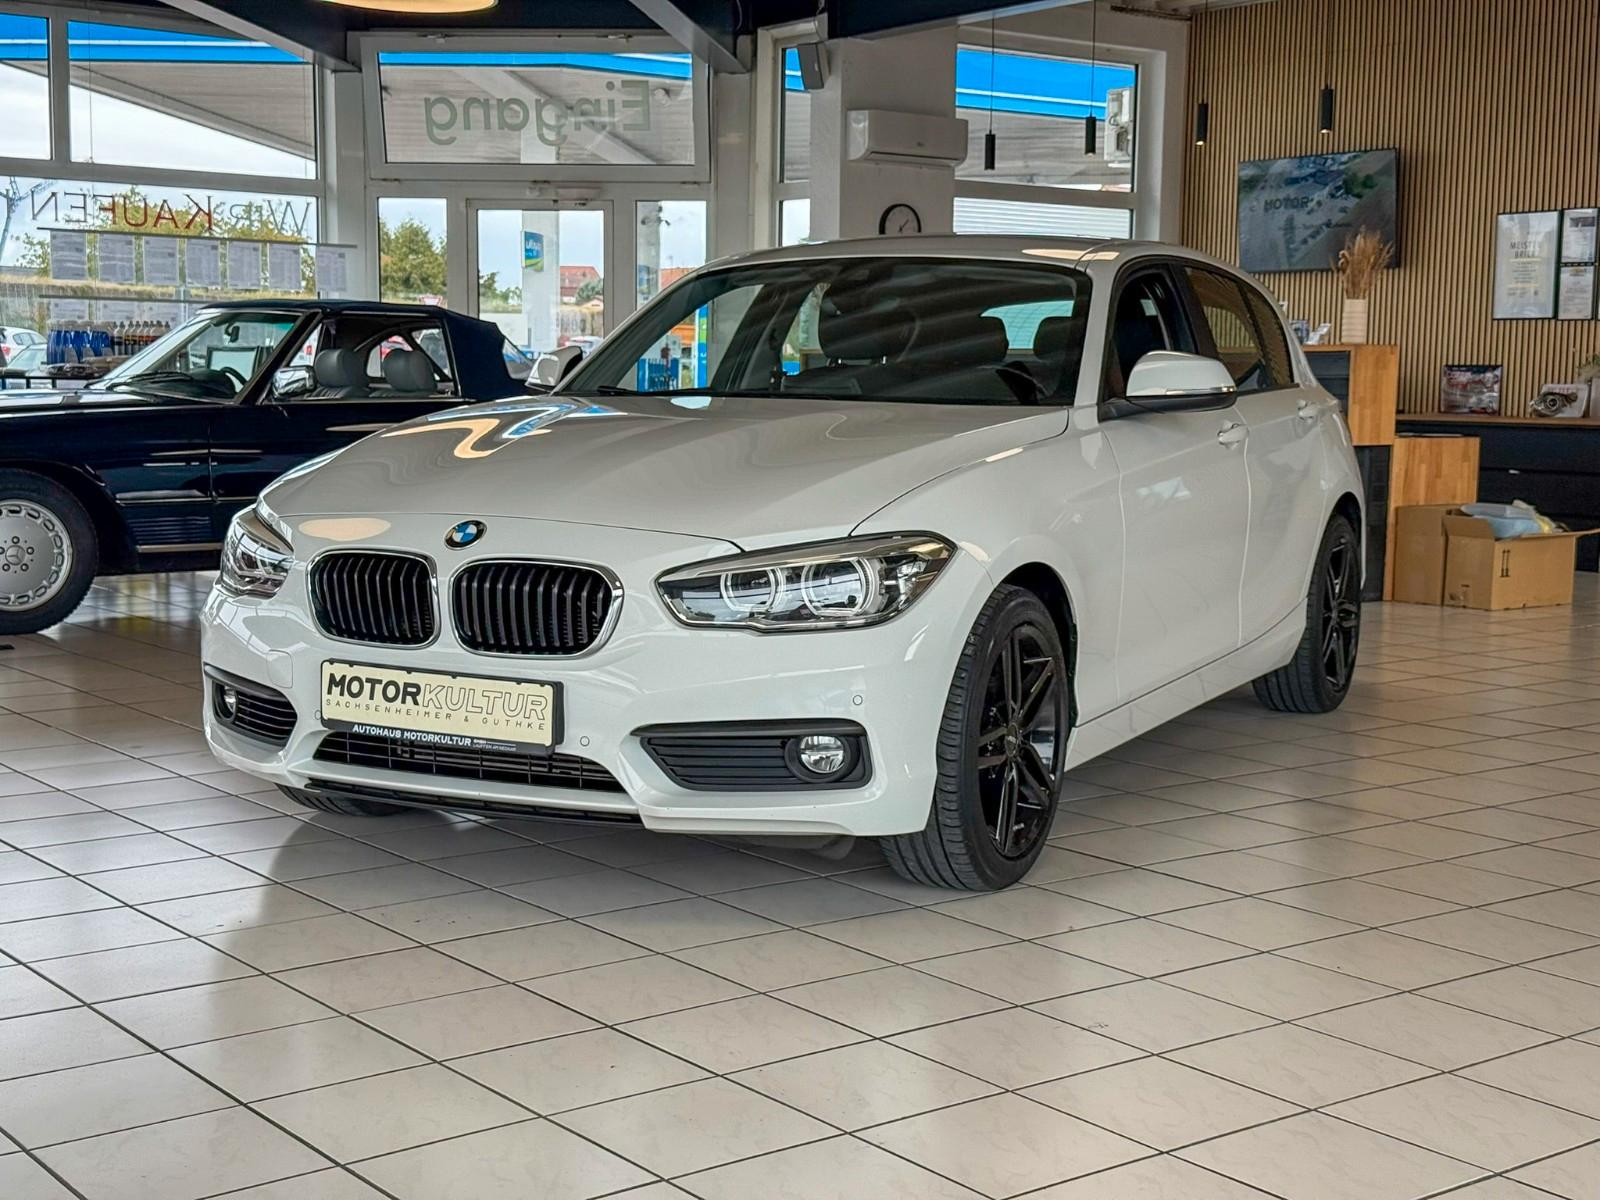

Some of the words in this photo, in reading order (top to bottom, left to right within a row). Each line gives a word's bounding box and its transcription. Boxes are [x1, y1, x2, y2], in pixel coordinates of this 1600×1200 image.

[327, 672, 549, 721] MOTORKULTUR
[326, 698, 452, 721] SACHSENHEIMER
[482, 717, 546, 731] GUTHKE
[352, 724, 402, 739] AUTOHAUS
[403, 730, 473, 747] MOTORKULTUR
